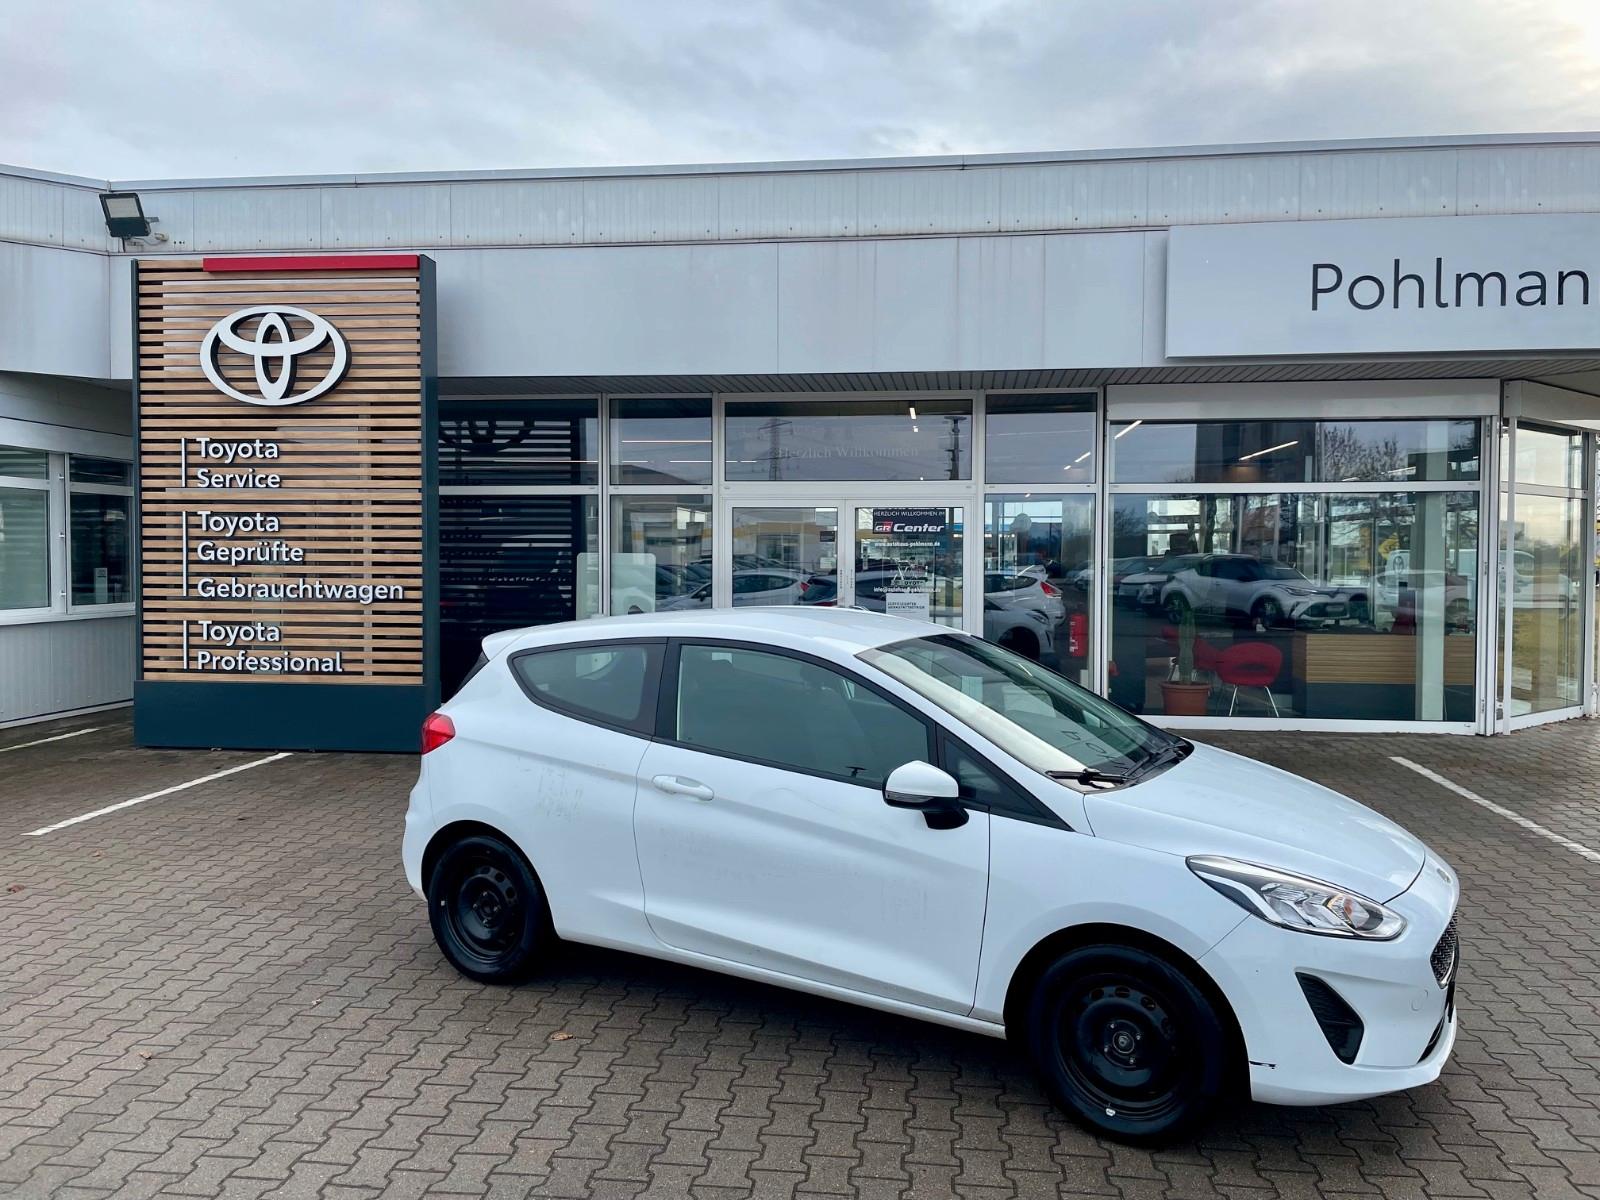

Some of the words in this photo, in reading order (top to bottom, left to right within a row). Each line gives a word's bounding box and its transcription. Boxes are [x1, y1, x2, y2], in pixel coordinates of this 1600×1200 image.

[196, 437, 279, 463] Toyota
[779, 447, 831, 458] Herzlich
[836, 446, 919, 458] Willkommen
[196, 469, 281, 488] Service
[197, 511, 279, 537] Toyota
[875, 524, 892, 532] GR
[893, 523, 945, 533] Center
[197, 542, 304, 566] Geprüfte
[197, 578, 405, 604] Gebrauchtwagen
[197, 621, 281, 647] Toyota
[197, 651, 343, 673] Professional
